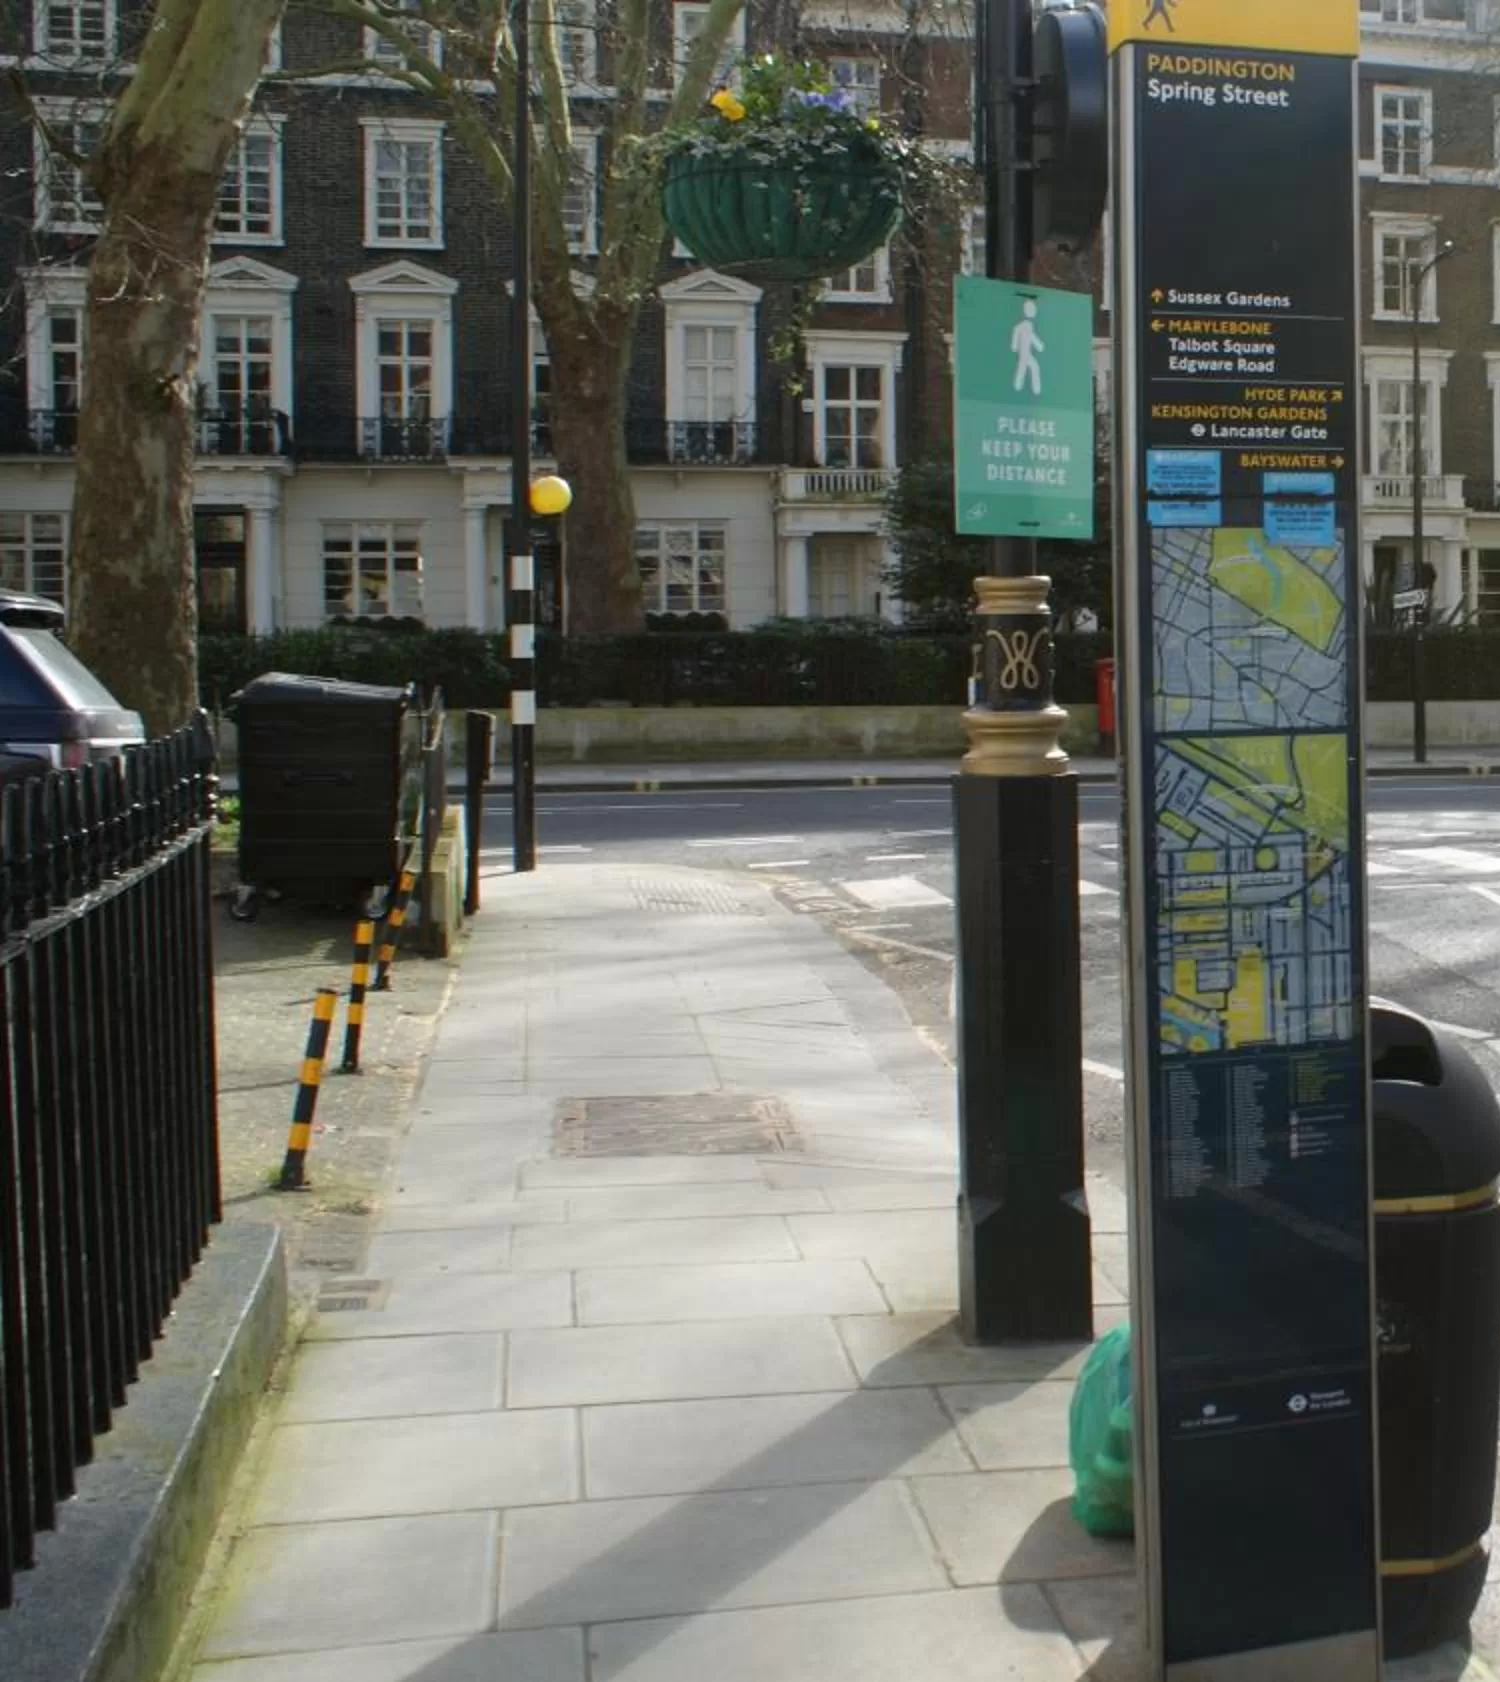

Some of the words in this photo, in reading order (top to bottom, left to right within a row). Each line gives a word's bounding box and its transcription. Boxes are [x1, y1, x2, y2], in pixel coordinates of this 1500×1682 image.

[1147, 53, 1295, 82] PADDINGTON
[1147, 78, 1216, 107] Spring
[1222, 83, 1289, 107] Street
[1168, 289, 1221, 305] Sussex
[1226, 291, 1291, 308] Gardens
[1168, 319, 1272, 335] MARYLEBONE
[1169, 337, 1219, 353] Talbot
[1223, 339, 1275, 356] Square
[1169, 356, 1233, 373] Edgware
[1238, 358, 1275, 373] Road
[1245, 387, 1285, 401] HYDE
[1290, 389, 1327, 402] PARK
[1152, 403, 1253, 420] KENSINGTON
[1257, 406, 1328, 421] GARDENS
[997, 416, 1057, 437] PLEASE
[1211, 423, 1285, 440] Lancaster
[1291, 426, 1328, 440] Gate
[981, 438, 1023, 458] KEEP
[1027, 442, 1071, 462] YOUR
[1240, 453, 1327, 468] BAYSWATER
[986, 463, 1067, 485] DISTANCE
